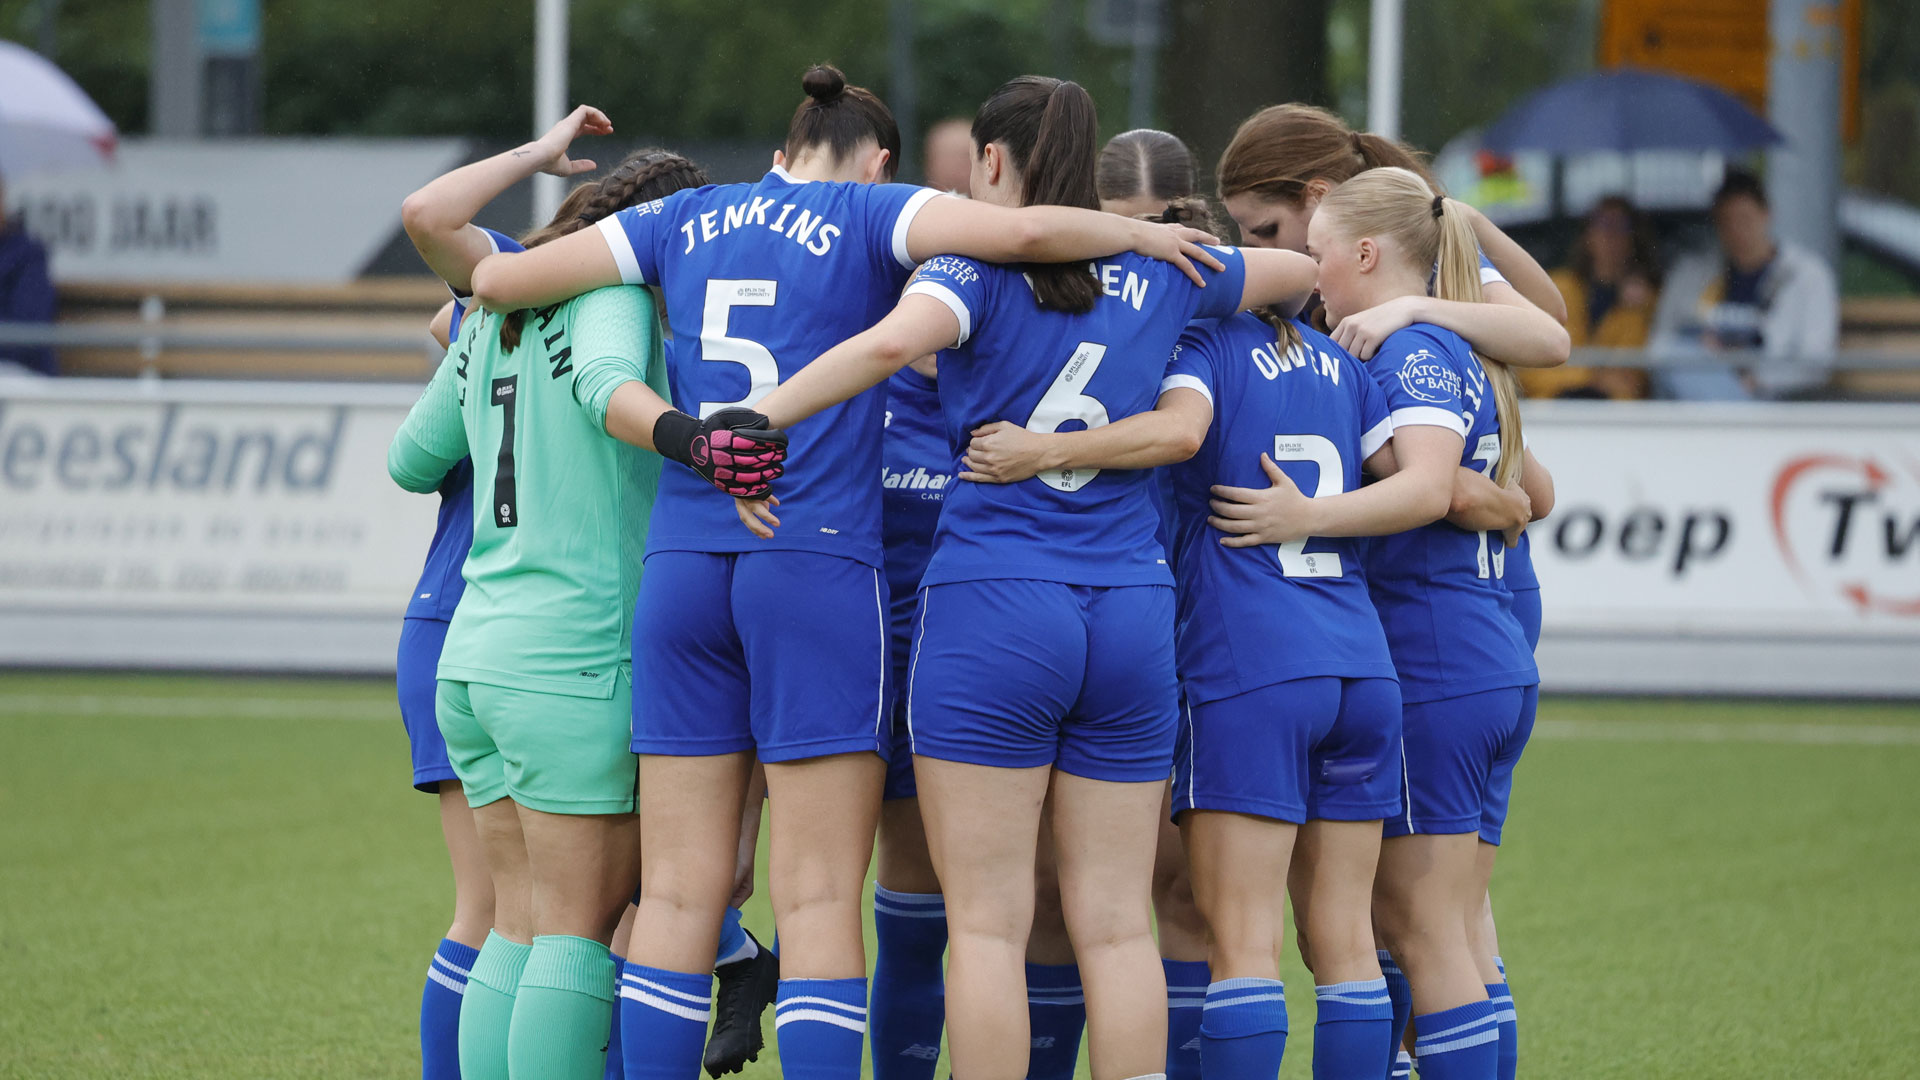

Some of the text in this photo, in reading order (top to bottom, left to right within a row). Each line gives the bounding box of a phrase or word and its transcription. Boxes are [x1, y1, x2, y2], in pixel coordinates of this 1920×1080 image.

[109, 194, 217, 252] JAAR
[681, 196, 841, 256] JENKINS
[929, 263, 970, 286] BATH
[700, 279, 779, 420] 5
[1395, 365, 1462, 389] WATCHES
[1025, 341, 1110, 493] 6
[1427, 376, 1462, 400] BATH
[0, 400, 353, 494] eesland
[490, 374, 518, 528] 1
[882, 466, 952, 490] atha
[1275, 434, 1344, 578] 2
[1533, 507, 1735, 579] oep
